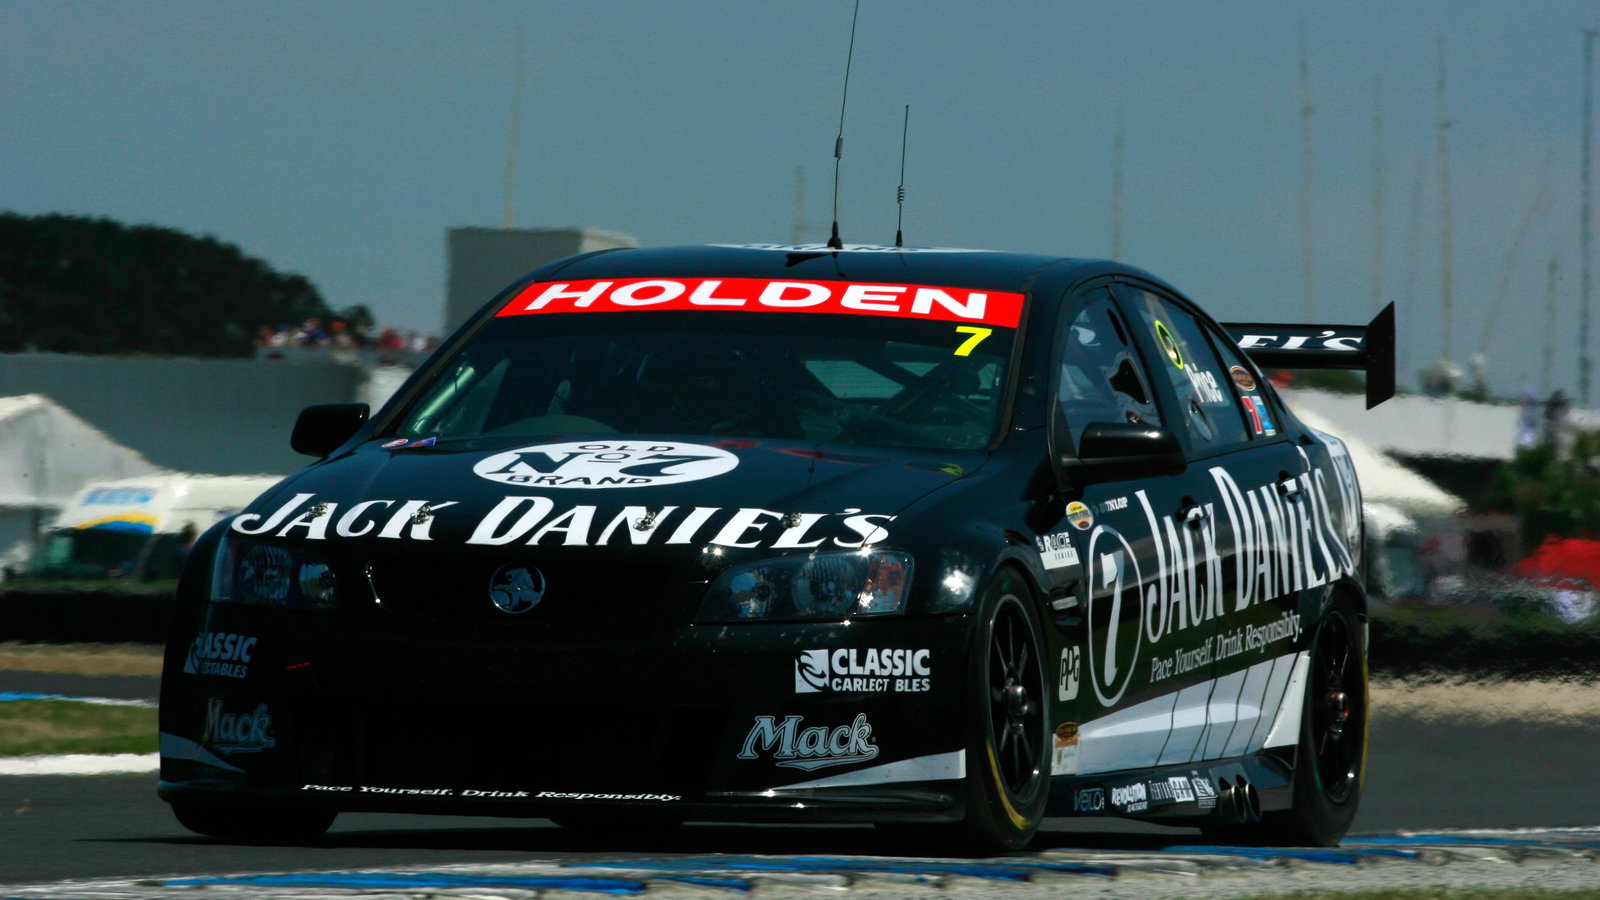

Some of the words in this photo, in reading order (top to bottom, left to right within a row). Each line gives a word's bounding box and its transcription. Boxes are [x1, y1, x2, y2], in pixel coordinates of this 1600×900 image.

[524, 280, 988, 319] HOLDEN
[952, 326, 992, 357] 7
[577, 444, 676, 452] OLD
[506, 475, 653, 486] BRAND
[231, 493, 460, 541] JACK
[465, 495, 898, 549] DANIEL'S
[1099, 496, 1128, 513] DUNLOP
[1134, 489, 1225, 643] JACK
[1208, 446, 1354, 612] DANIEL'S
[1100, 550, 1124, 687] 7
[831, 648, 931, 676] CLASSIC
[1149, 654, 1174, 683] Pace
[1173, 636, 1214, 676] Yourself.
[1214, 627, 1244, 661] Drink
[1244, 609, 1303, 654] Responsibly.
[736, 712, 880, 767] Mack
[301, 784, 353, 792] Pace
[359, 786, 453, 796] Yourself.
[460, 789, 530, 797] Drink
[535, 791, 682, 801] Responsibly.
